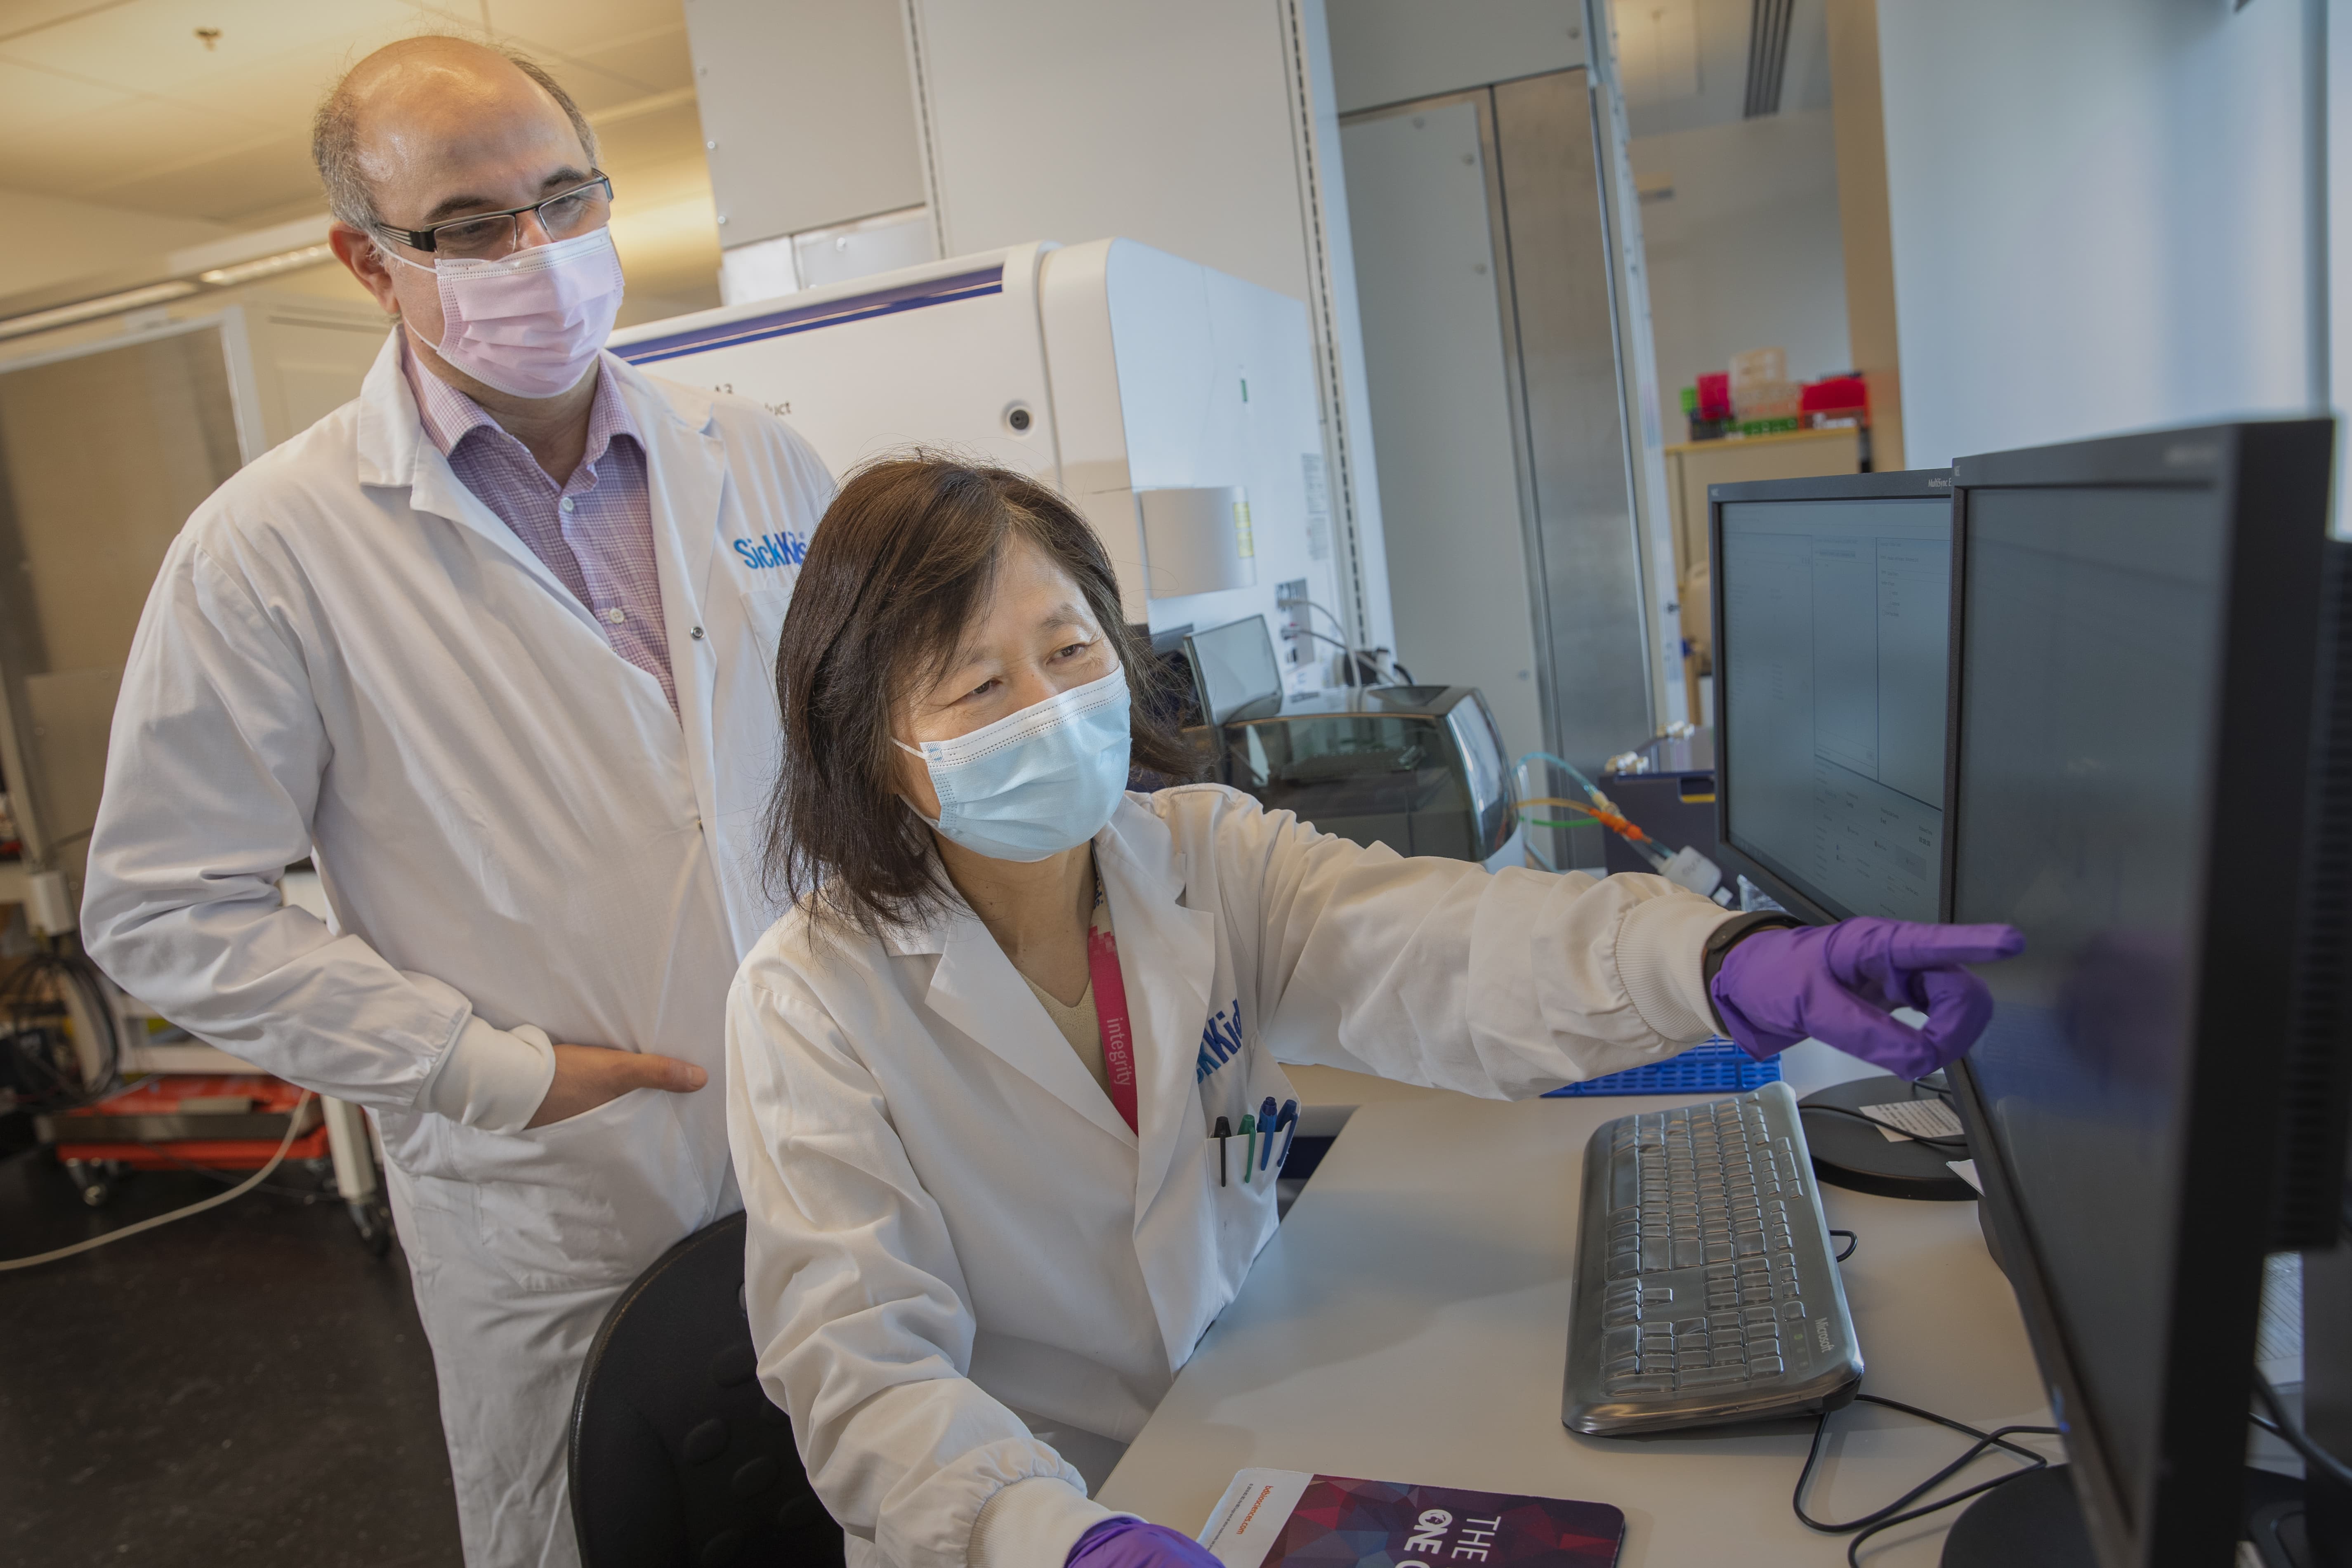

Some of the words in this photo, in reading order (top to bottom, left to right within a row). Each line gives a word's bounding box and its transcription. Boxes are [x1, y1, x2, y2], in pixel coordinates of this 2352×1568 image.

[1106, 1017, 1132, 1087] integrity
[1815, 1317, 1835, 1353] Microsoft
[1236, 1485, 1274, 1535] bdbiosciences.com
[1404, 1509, 1453, 1554] ONE
[1451, 1516, 1501, 1562] THE
